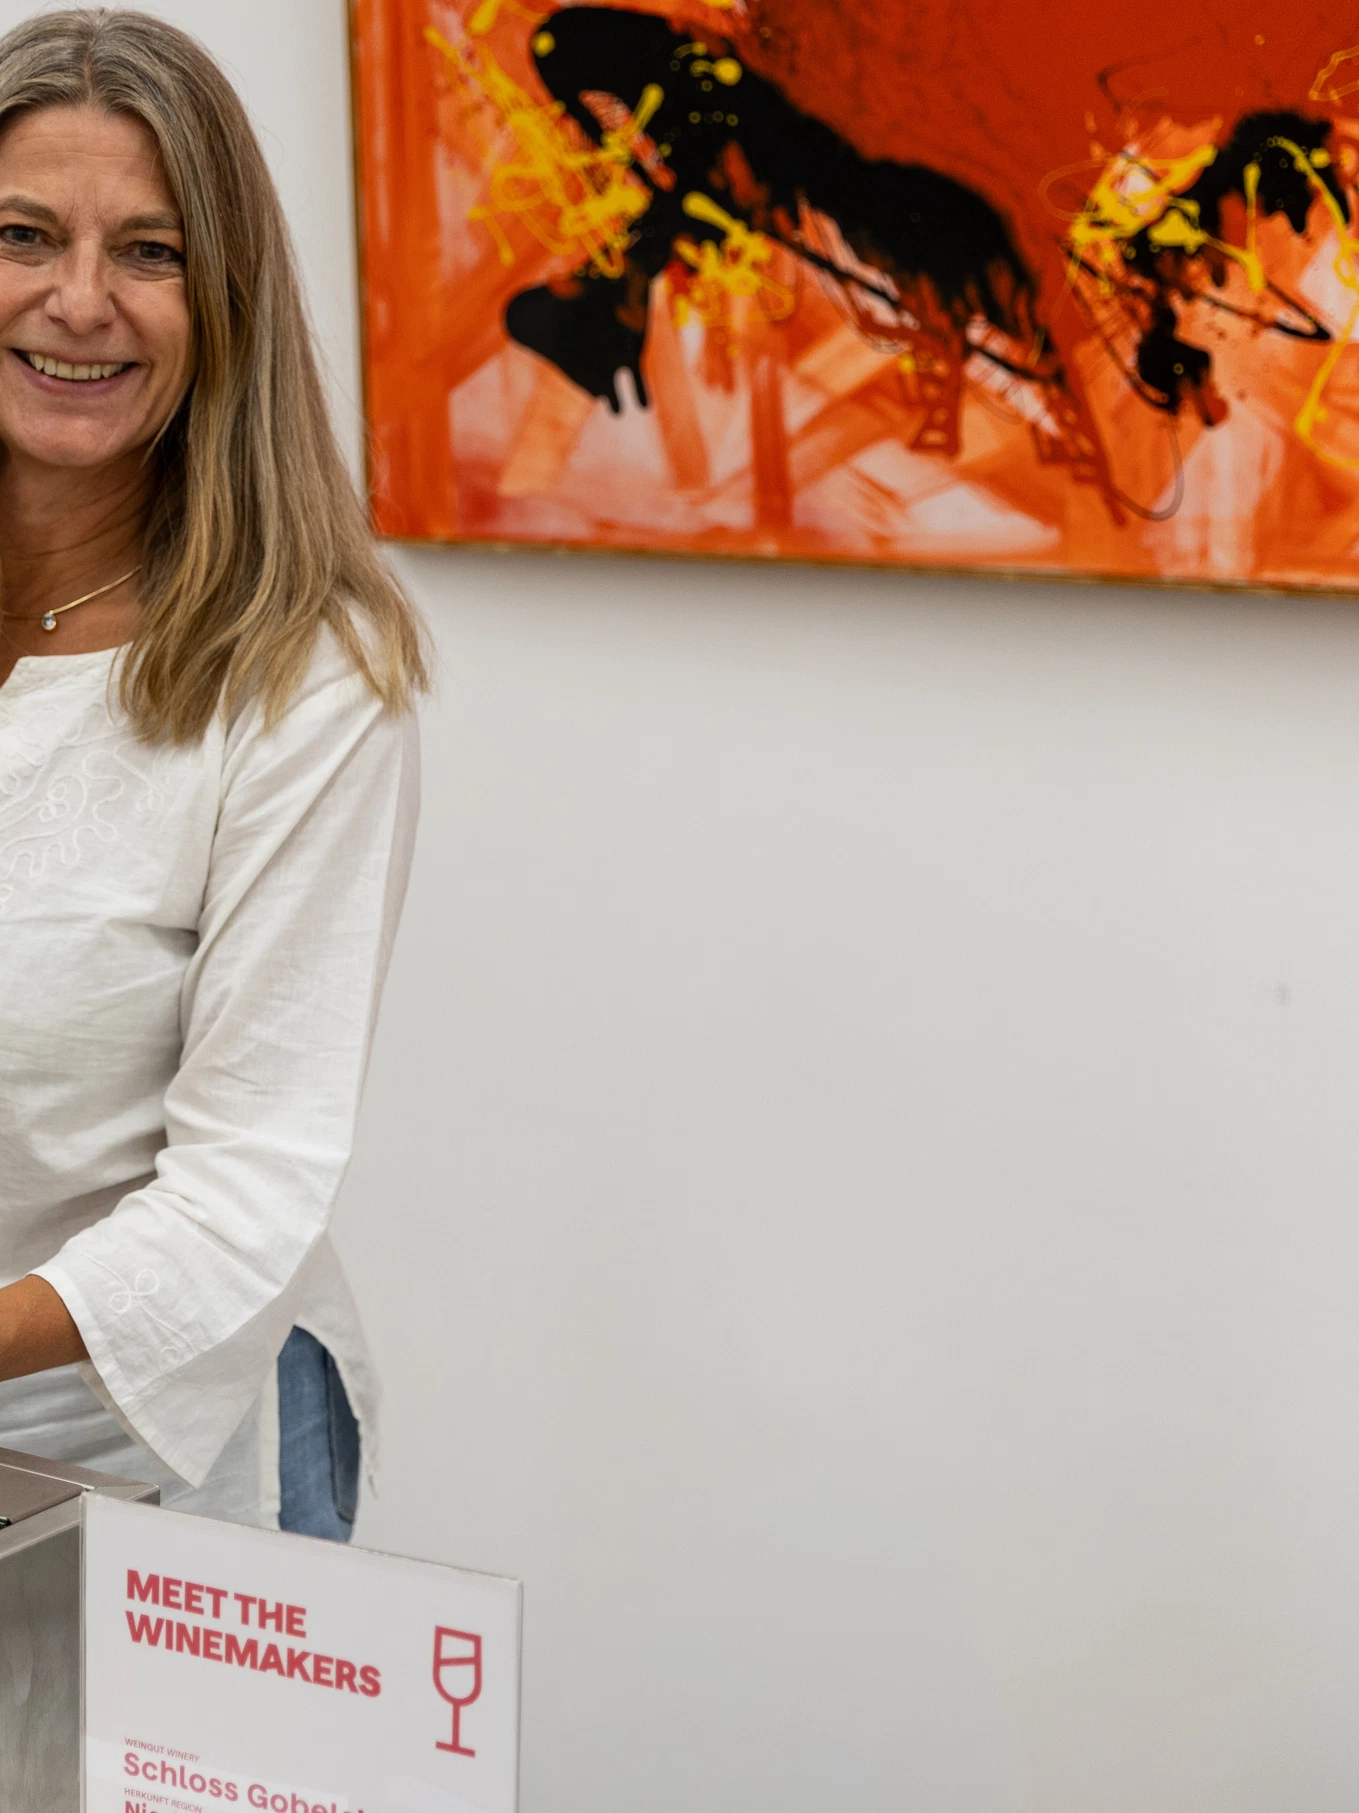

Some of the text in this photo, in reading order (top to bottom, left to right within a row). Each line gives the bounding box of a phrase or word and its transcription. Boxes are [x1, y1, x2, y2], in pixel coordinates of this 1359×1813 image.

[126, 1568, 308, 1640] MEET THE
[124, 1610, 382, 1698] WINEMAKERS
[124, 1737, 201, 1763] WEINGUT WINERY
[123, 1751, 239, 1802] Schloss
[124, 1787, 169, 1805] HERKUNFT
[171, 1799, 203, 1813] REGION
